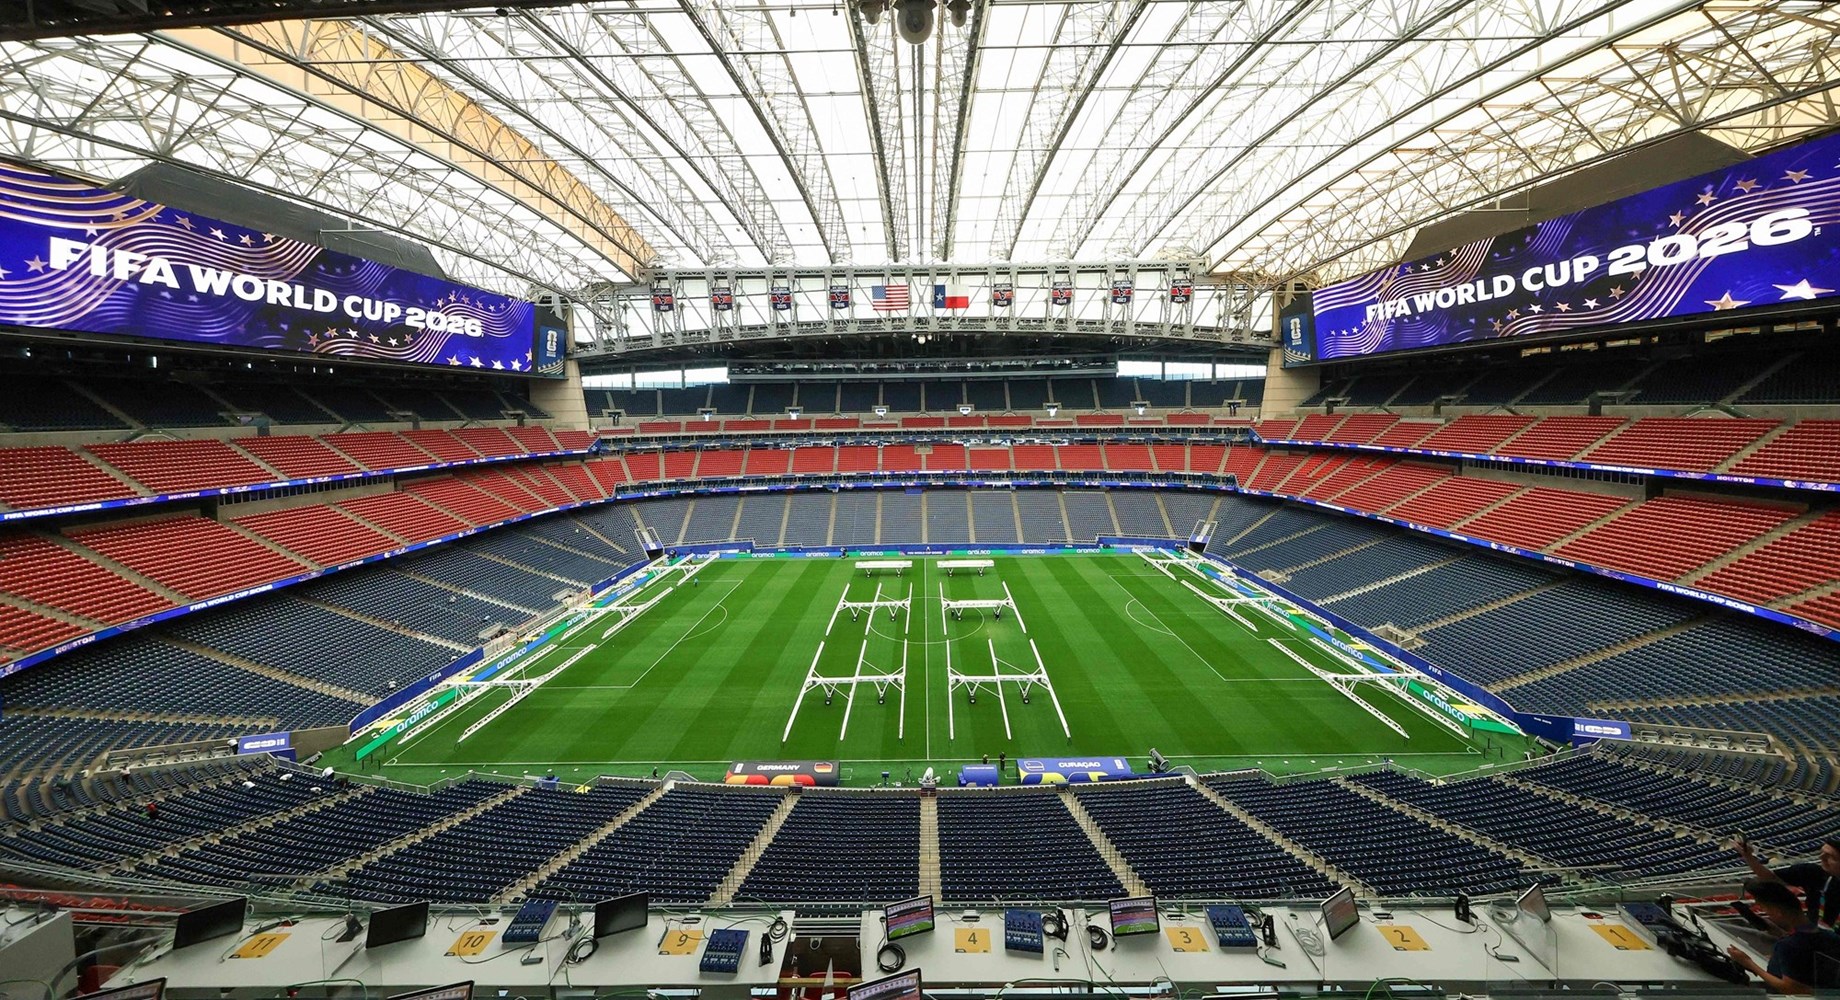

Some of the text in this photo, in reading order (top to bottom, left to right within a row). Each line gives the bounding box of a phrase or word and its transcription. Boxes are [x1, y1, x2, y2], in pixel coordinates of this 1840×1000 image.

[1364, 299, 1410, 323] FIFA
[1412, 274, 1515, 313] WORLD
[1520, 255, 1599, 291] CUP
[1607, 208, 1812, 276] 2026
[49, 235, 484, 337] FIFA WORLD CUP 2026
[1717, 475, 1755, 483] HOUSTON
[168, 492, 200, 500] HOUSTON
[4, 512, 24, 520] FIFA
[24, 509, 56, 517] WORLD
[1543, 556, 1575, 567] HOUSTON
[1656, 583, 1675, 592] FIFA
[1675, 587, 1707, 599] WORLD
[1708, 595, 1726, 604] CUP
[190, 602, 208, 611] FIFA
[207, 595, 234, 606] WORLD
[235, 591, 250, 599] CUP
[55, 635, 96, 654] HOUSTON
[1331, 637, 1364, 660] aramco
[497, 646, 527, 670] aramco
[429, 672, 442, 682] FIFA
[1428, 665, 1442, 676] FIFA
[1423, 690, 1465, 722] aramco
[396, 700, 439, 733] aramco
[1058, 761, 1101, 769] CURAÇAO
[463, 935, 485, 948] 10
[676, 934, 688, 947] 9
[968, 932, 978, 944] 4
[1179, 931, 1191, 944] 3
[1393, 930, 1411, 942] 2
[1609, 929, 1627, 941] 1
[252, 937, 277, 950] 11
